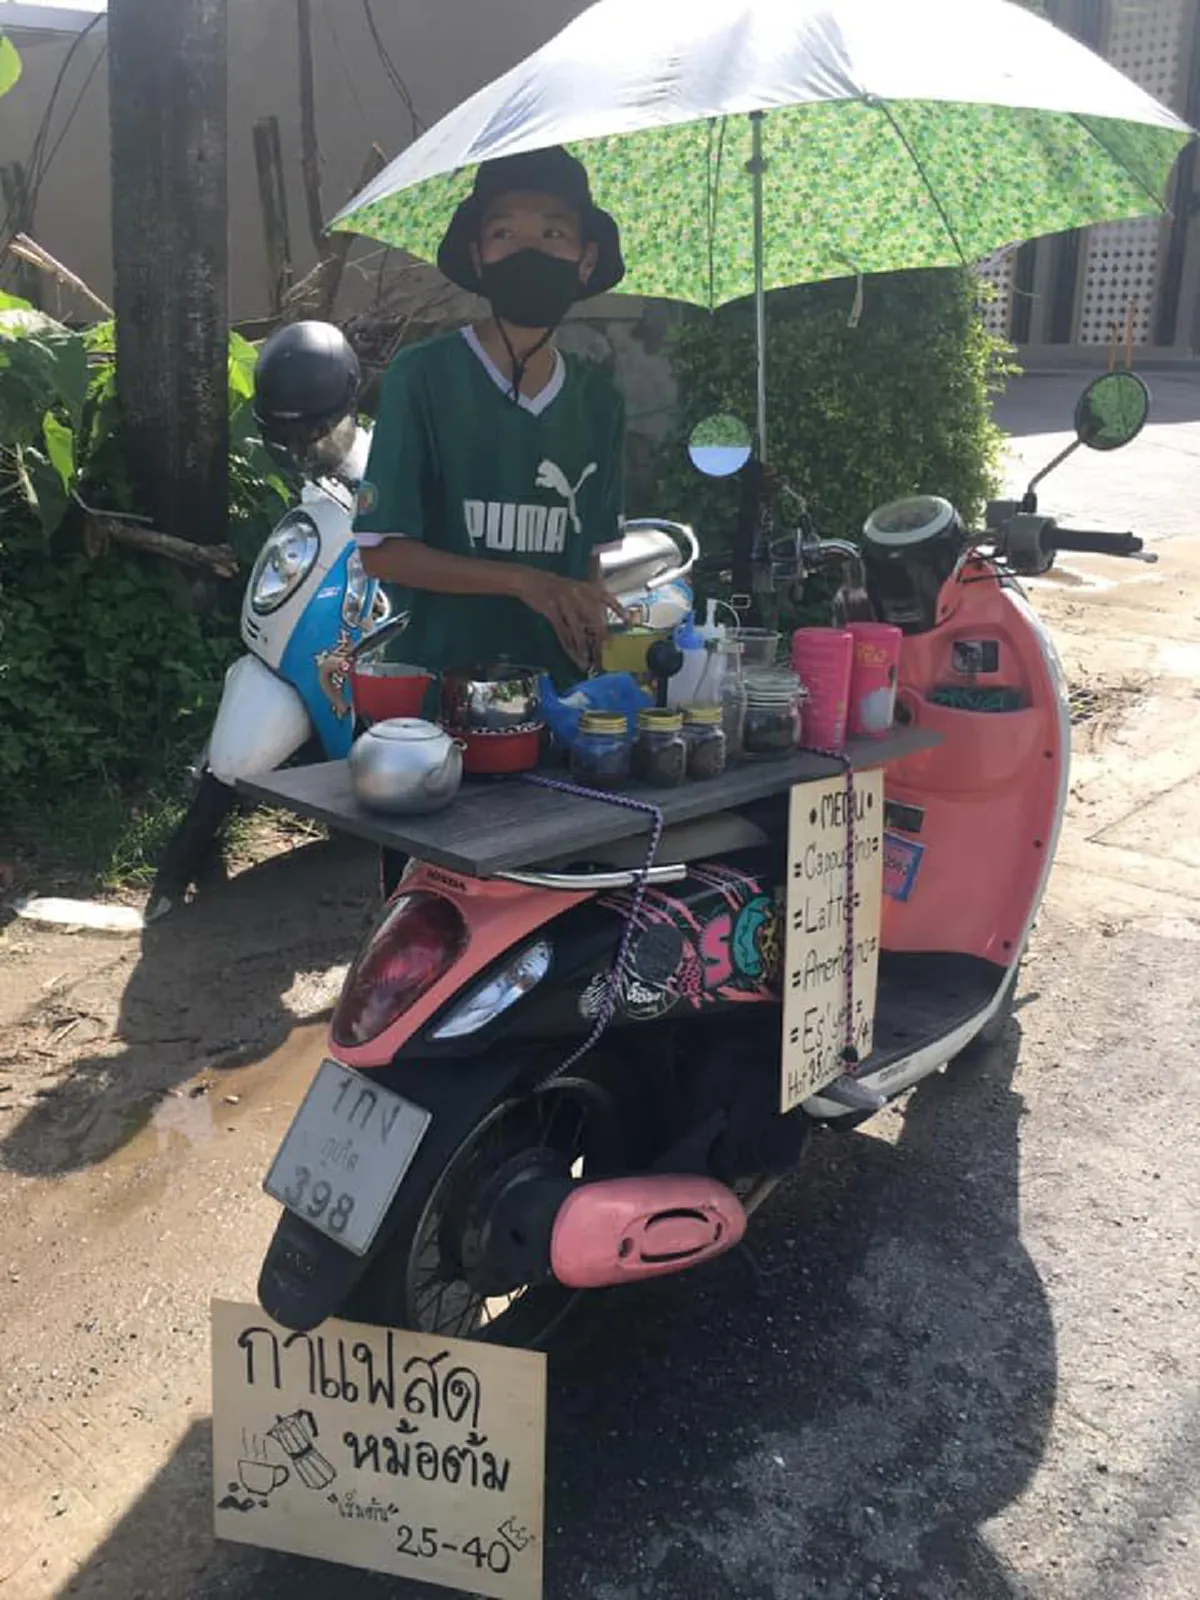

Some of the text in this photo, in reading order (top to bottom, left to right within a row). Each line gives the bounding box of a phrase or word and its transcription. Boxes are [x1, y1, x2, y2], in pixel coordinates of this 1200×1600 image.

[463, 498, 569, 553] PUMA
[284, 1166, 355, 1233] 398
[237, 1326, 481, 1428] กาแฟสด
[343, 1418, 511, 1492] หม้อต้ม
[396, 1524, 511, 1574] 25-40
